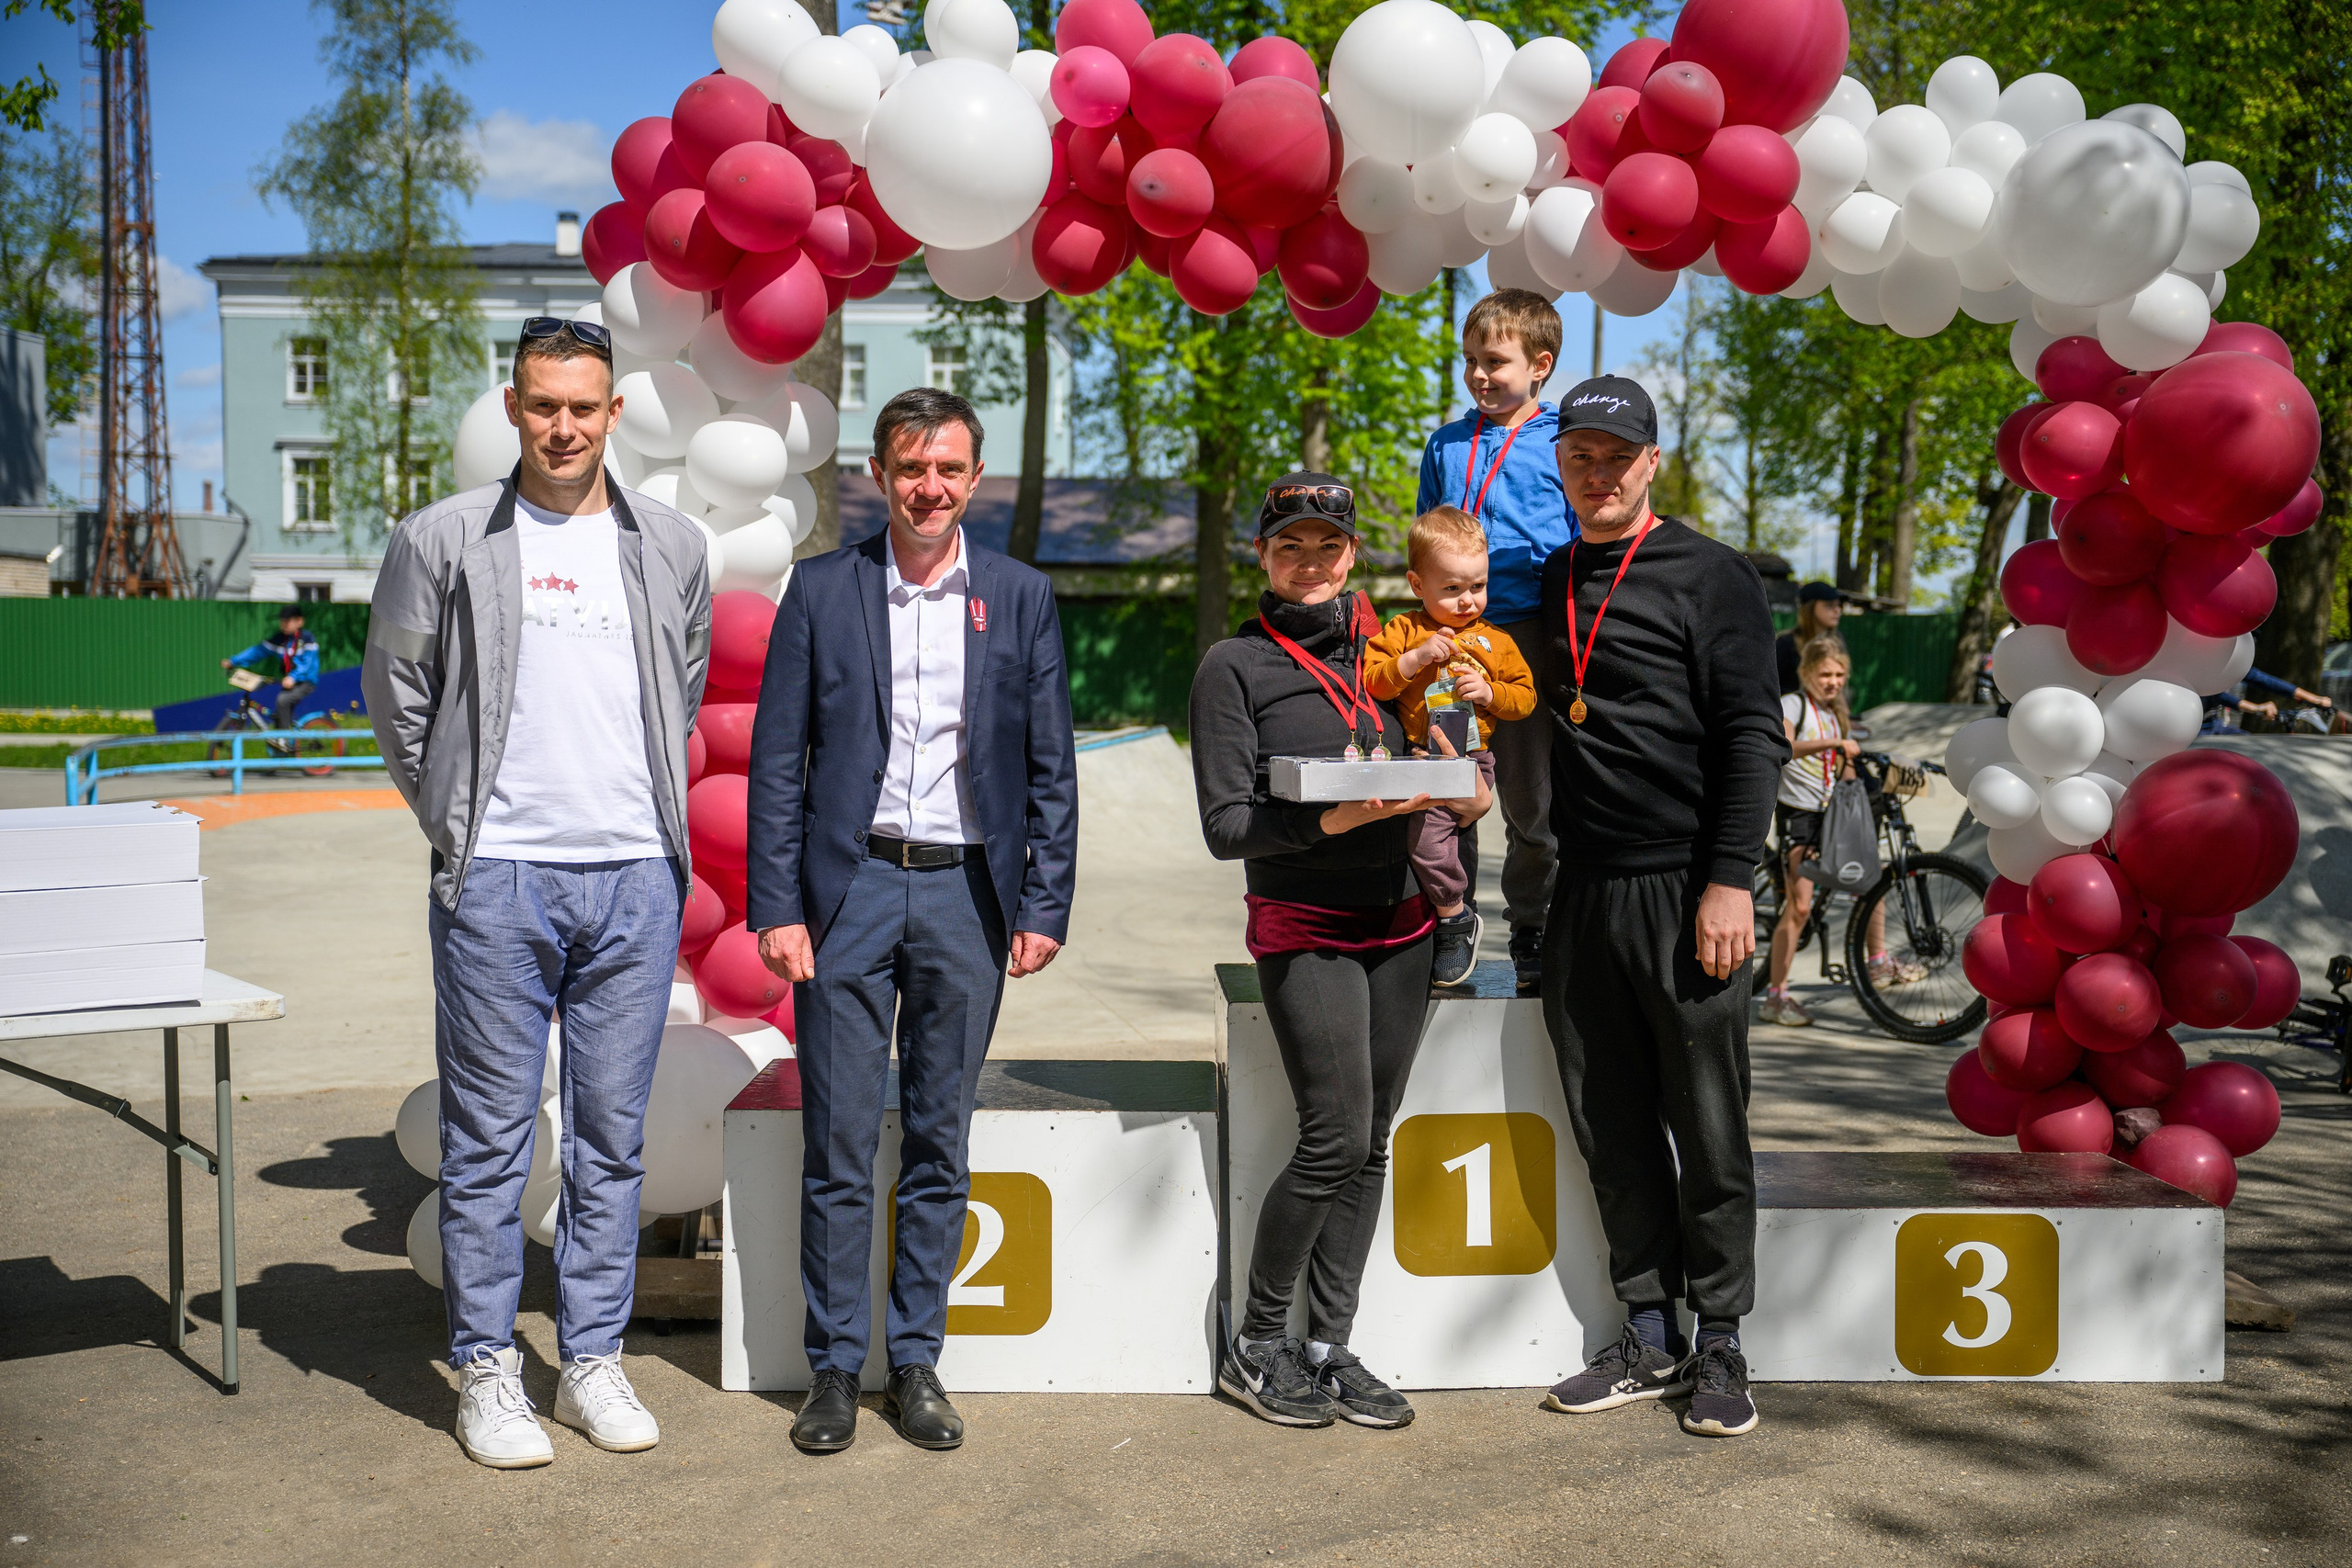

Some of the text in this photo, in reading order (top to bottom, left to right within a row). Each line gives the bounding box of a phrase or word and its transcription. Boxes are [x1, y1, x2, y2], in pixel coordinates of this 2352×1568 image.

[1572, 393, 1631, 413] change
[1441, 1142, 1492, 1247] 1
[946, 1200, 1005, 1307] 2
[1941, 1241, 2012, 1348] 3
